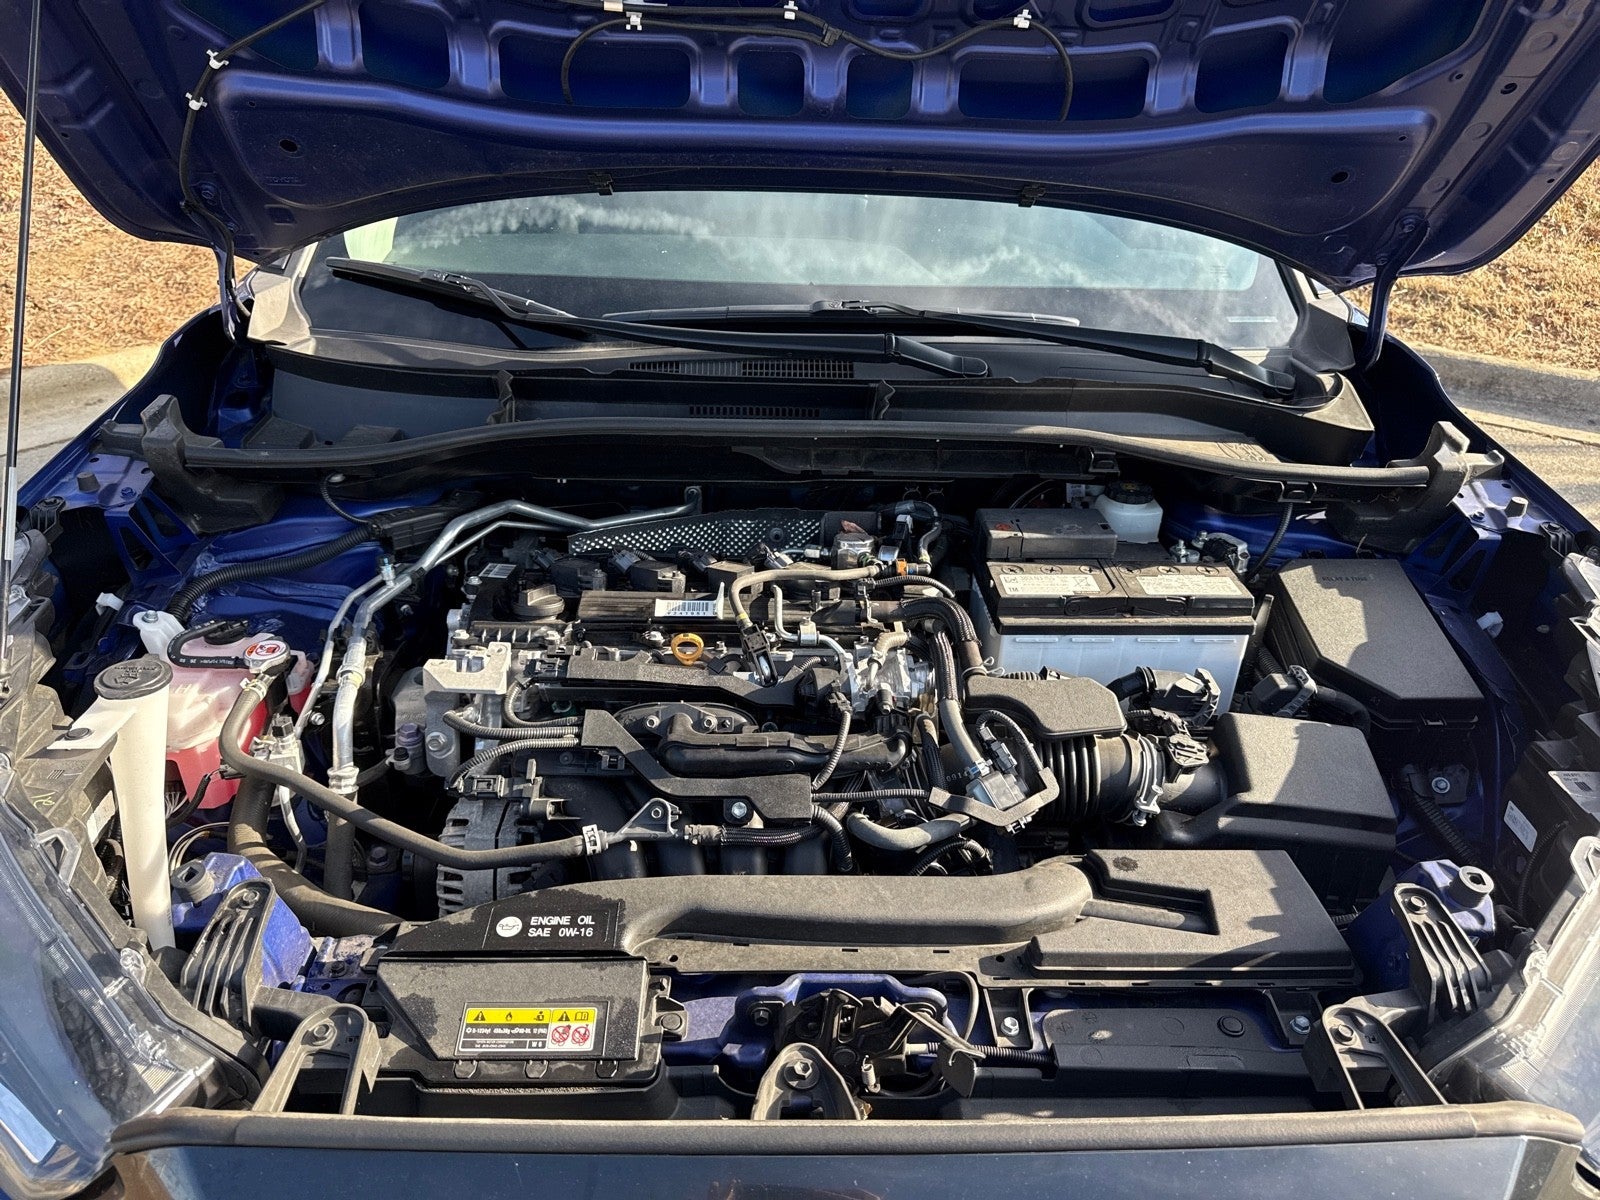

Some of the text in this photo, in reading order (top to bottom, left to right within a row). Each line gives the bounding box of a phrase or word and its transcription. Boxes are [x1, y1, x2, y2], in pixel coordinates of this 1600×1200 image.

[530, 915, 595, 926] ENGINE OIL
[528, 927, 594, 937] SAE 0W-16
